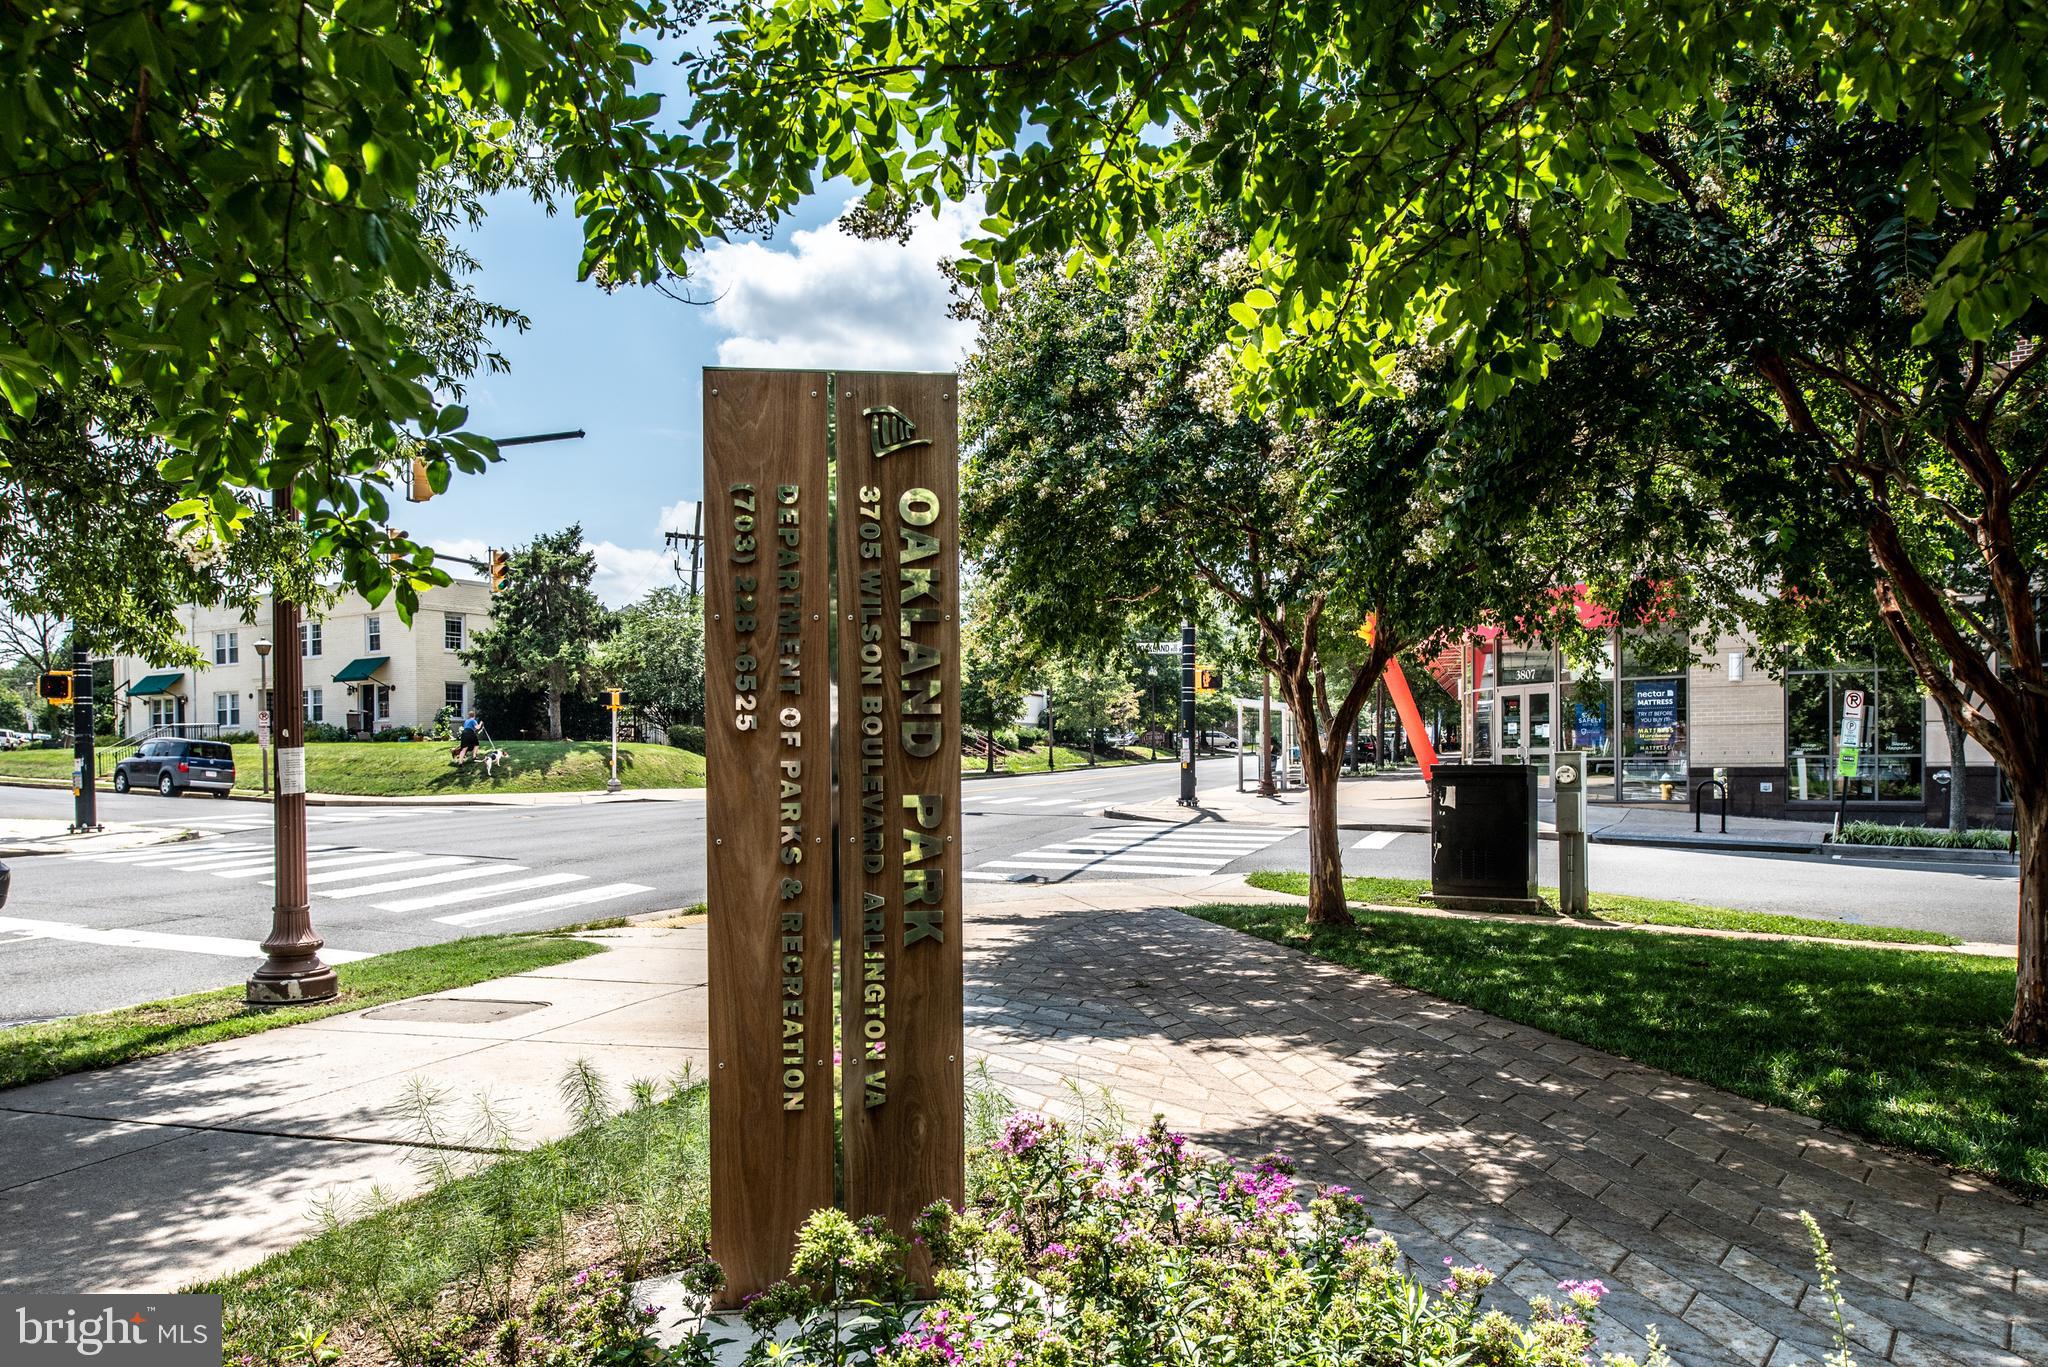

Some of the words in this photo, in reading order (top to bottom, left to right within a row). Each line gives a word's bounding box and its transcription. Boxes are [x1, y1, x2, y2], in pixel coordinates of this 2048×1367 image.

[729, 483, 757, 564] (703)
[859, 485, 882, 559] 3705
[777, 485, 801, 695] DEPARTMENT
[860, 569, 883, 685] WILSON
[899, 487, 942, 758] OAKLAND
[779, 707, 802, 747] OF
[1516, 669, 1536, 680] 3807
[1637, 690, 1665, 698] nectar
[780, 760, 803, 865] PARKS
[861, 696, 885, 874] BOULEVARD
[780, 877, 803, 900] &
[902, 794, 944, 948] PARK
[781, 912, 805, 1111] RECREATION
[863, 891, 887, 1060] ARLINGTON
[864, 1070, 887, 1109] VA
